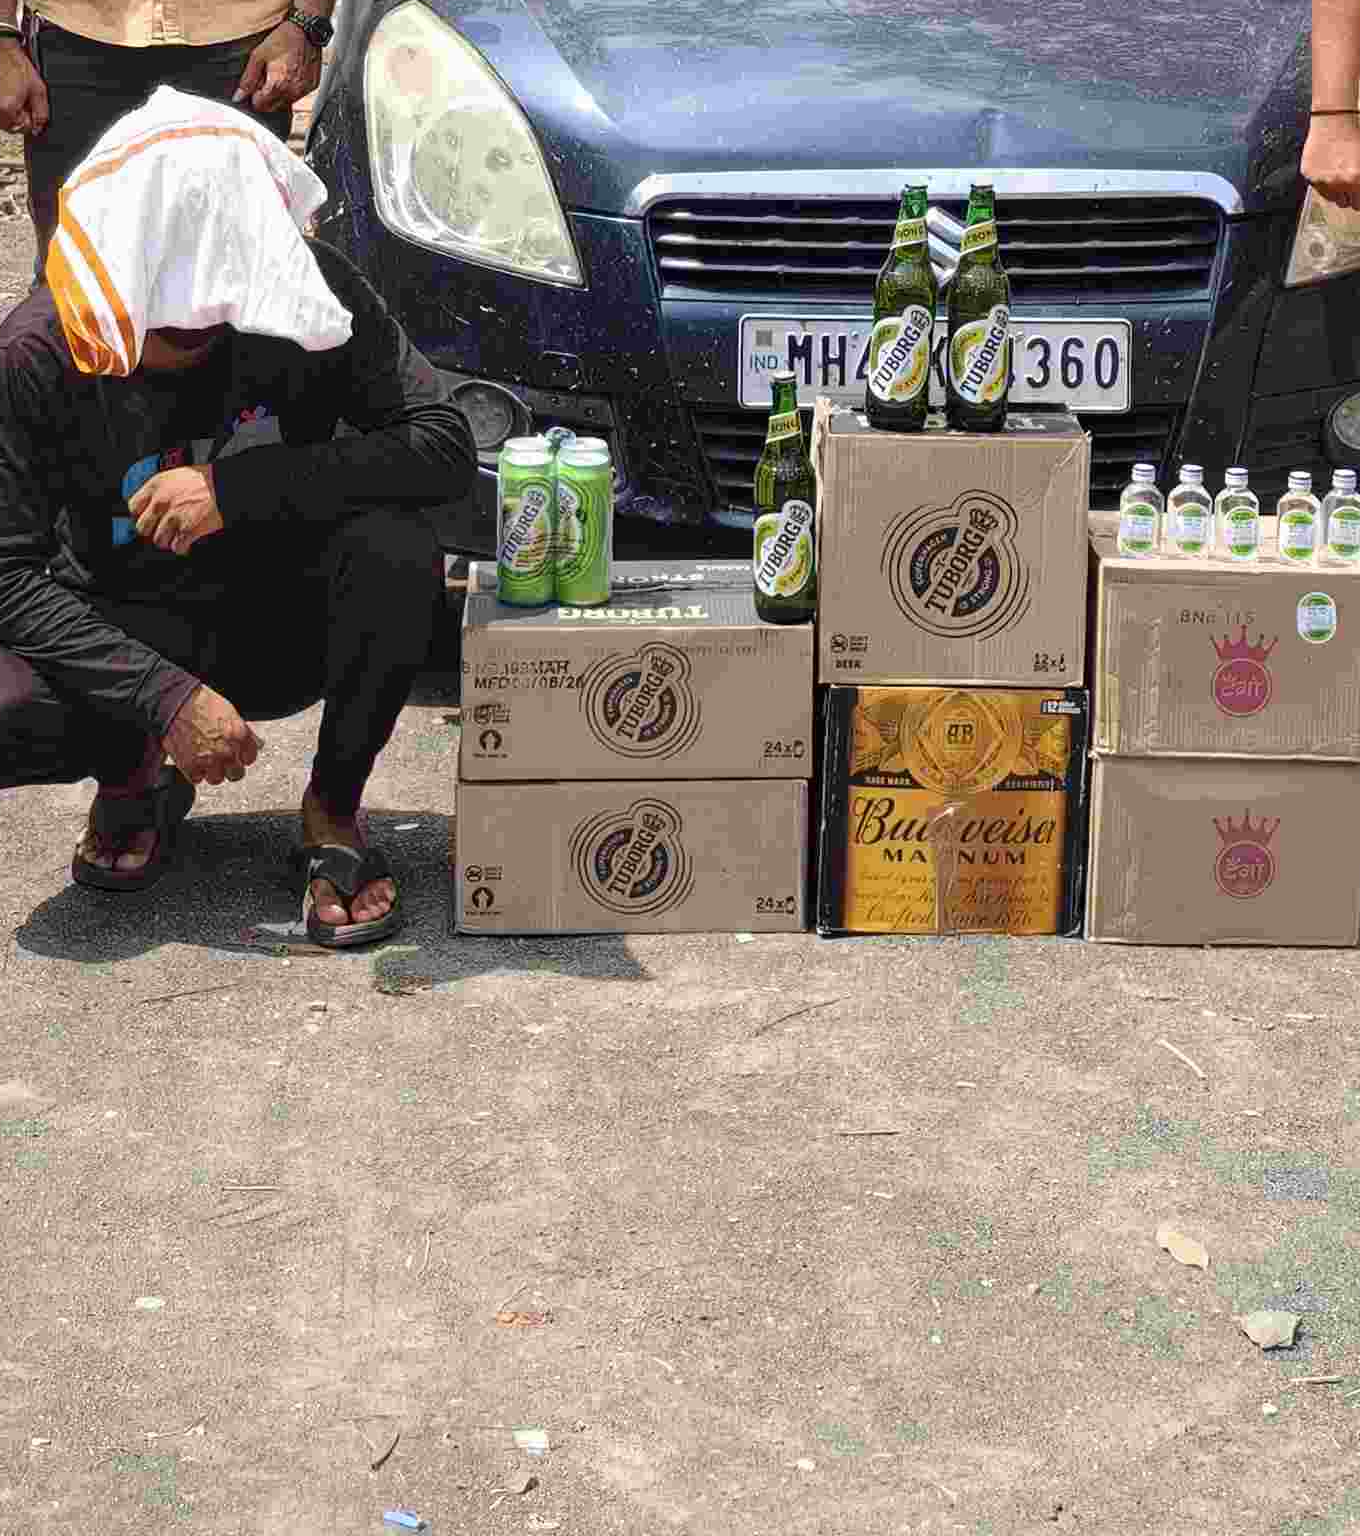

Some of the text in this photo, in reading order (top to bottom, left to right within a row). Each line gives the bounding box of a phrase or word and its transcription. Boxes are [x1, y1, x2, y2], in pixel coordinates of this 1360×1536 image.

[749, 354, 778, 370] IND
[872, 325, 921, 393] TUBORG
[959, 326, 1006, 395] TUBORG
[502, 504, 539, 561] TUBORG
[758, 520, 801, 588] TUBORG
[924, 527, 985, 614] TUBORG
[616, 670, 671, 739] TUBORG
[608, 826, 662, 896] TUBORG
[882, 848, 1025, 864] MANUM
